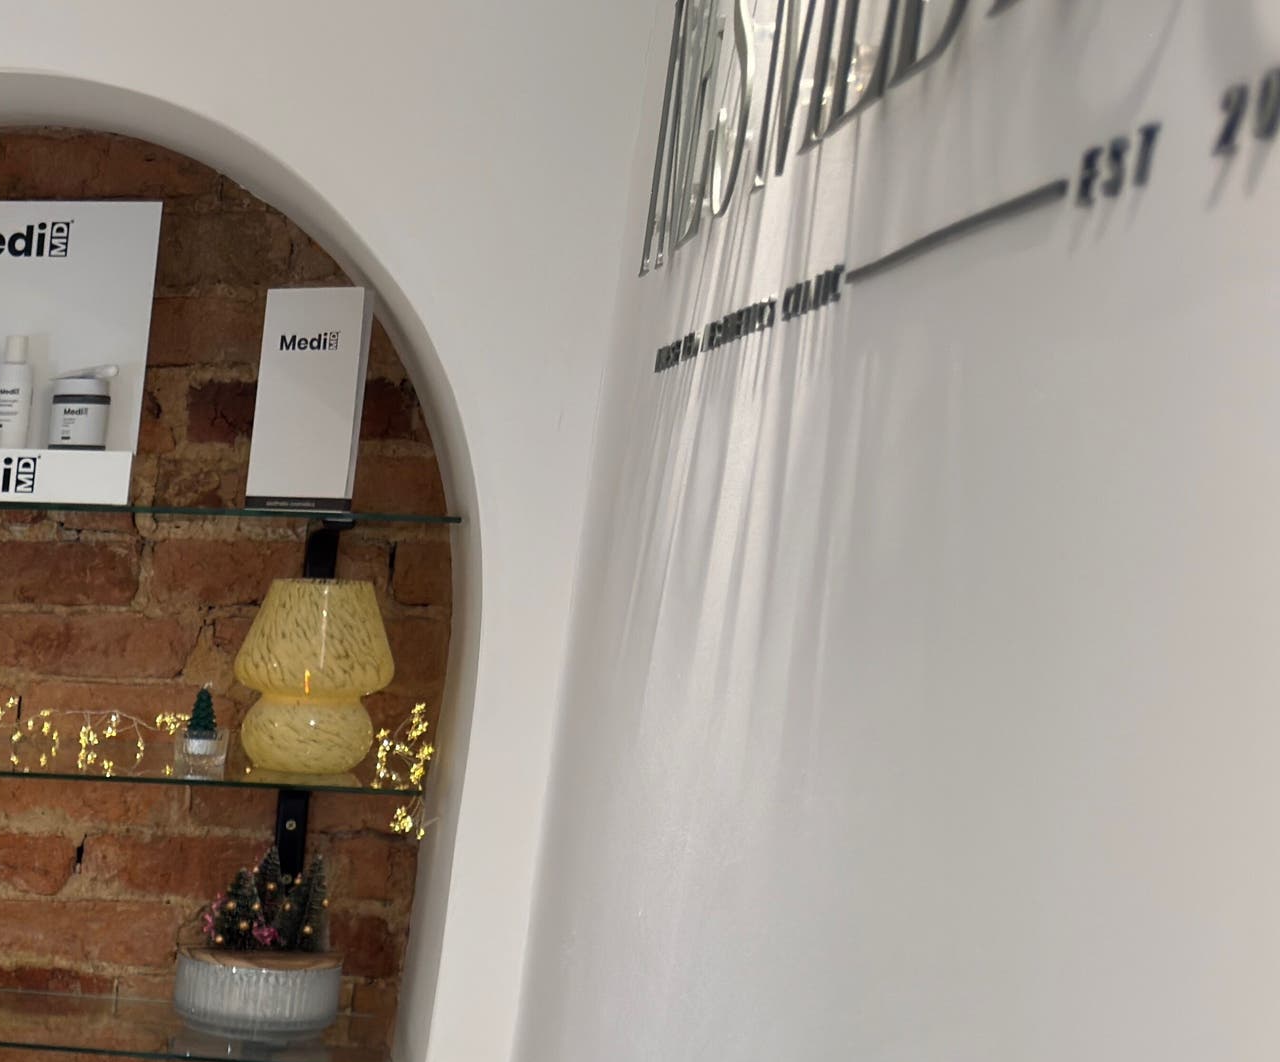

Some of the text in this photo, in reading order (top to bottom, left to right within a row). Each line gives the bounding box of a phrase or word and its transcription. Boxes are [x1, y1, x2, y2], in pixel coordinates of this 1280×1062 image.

[1075, 121, 1162, 208] EST
[49, 222, 70, 257] MD
[280, 332, 328, 351] Medi
[15, 456, 37, 494] MD
